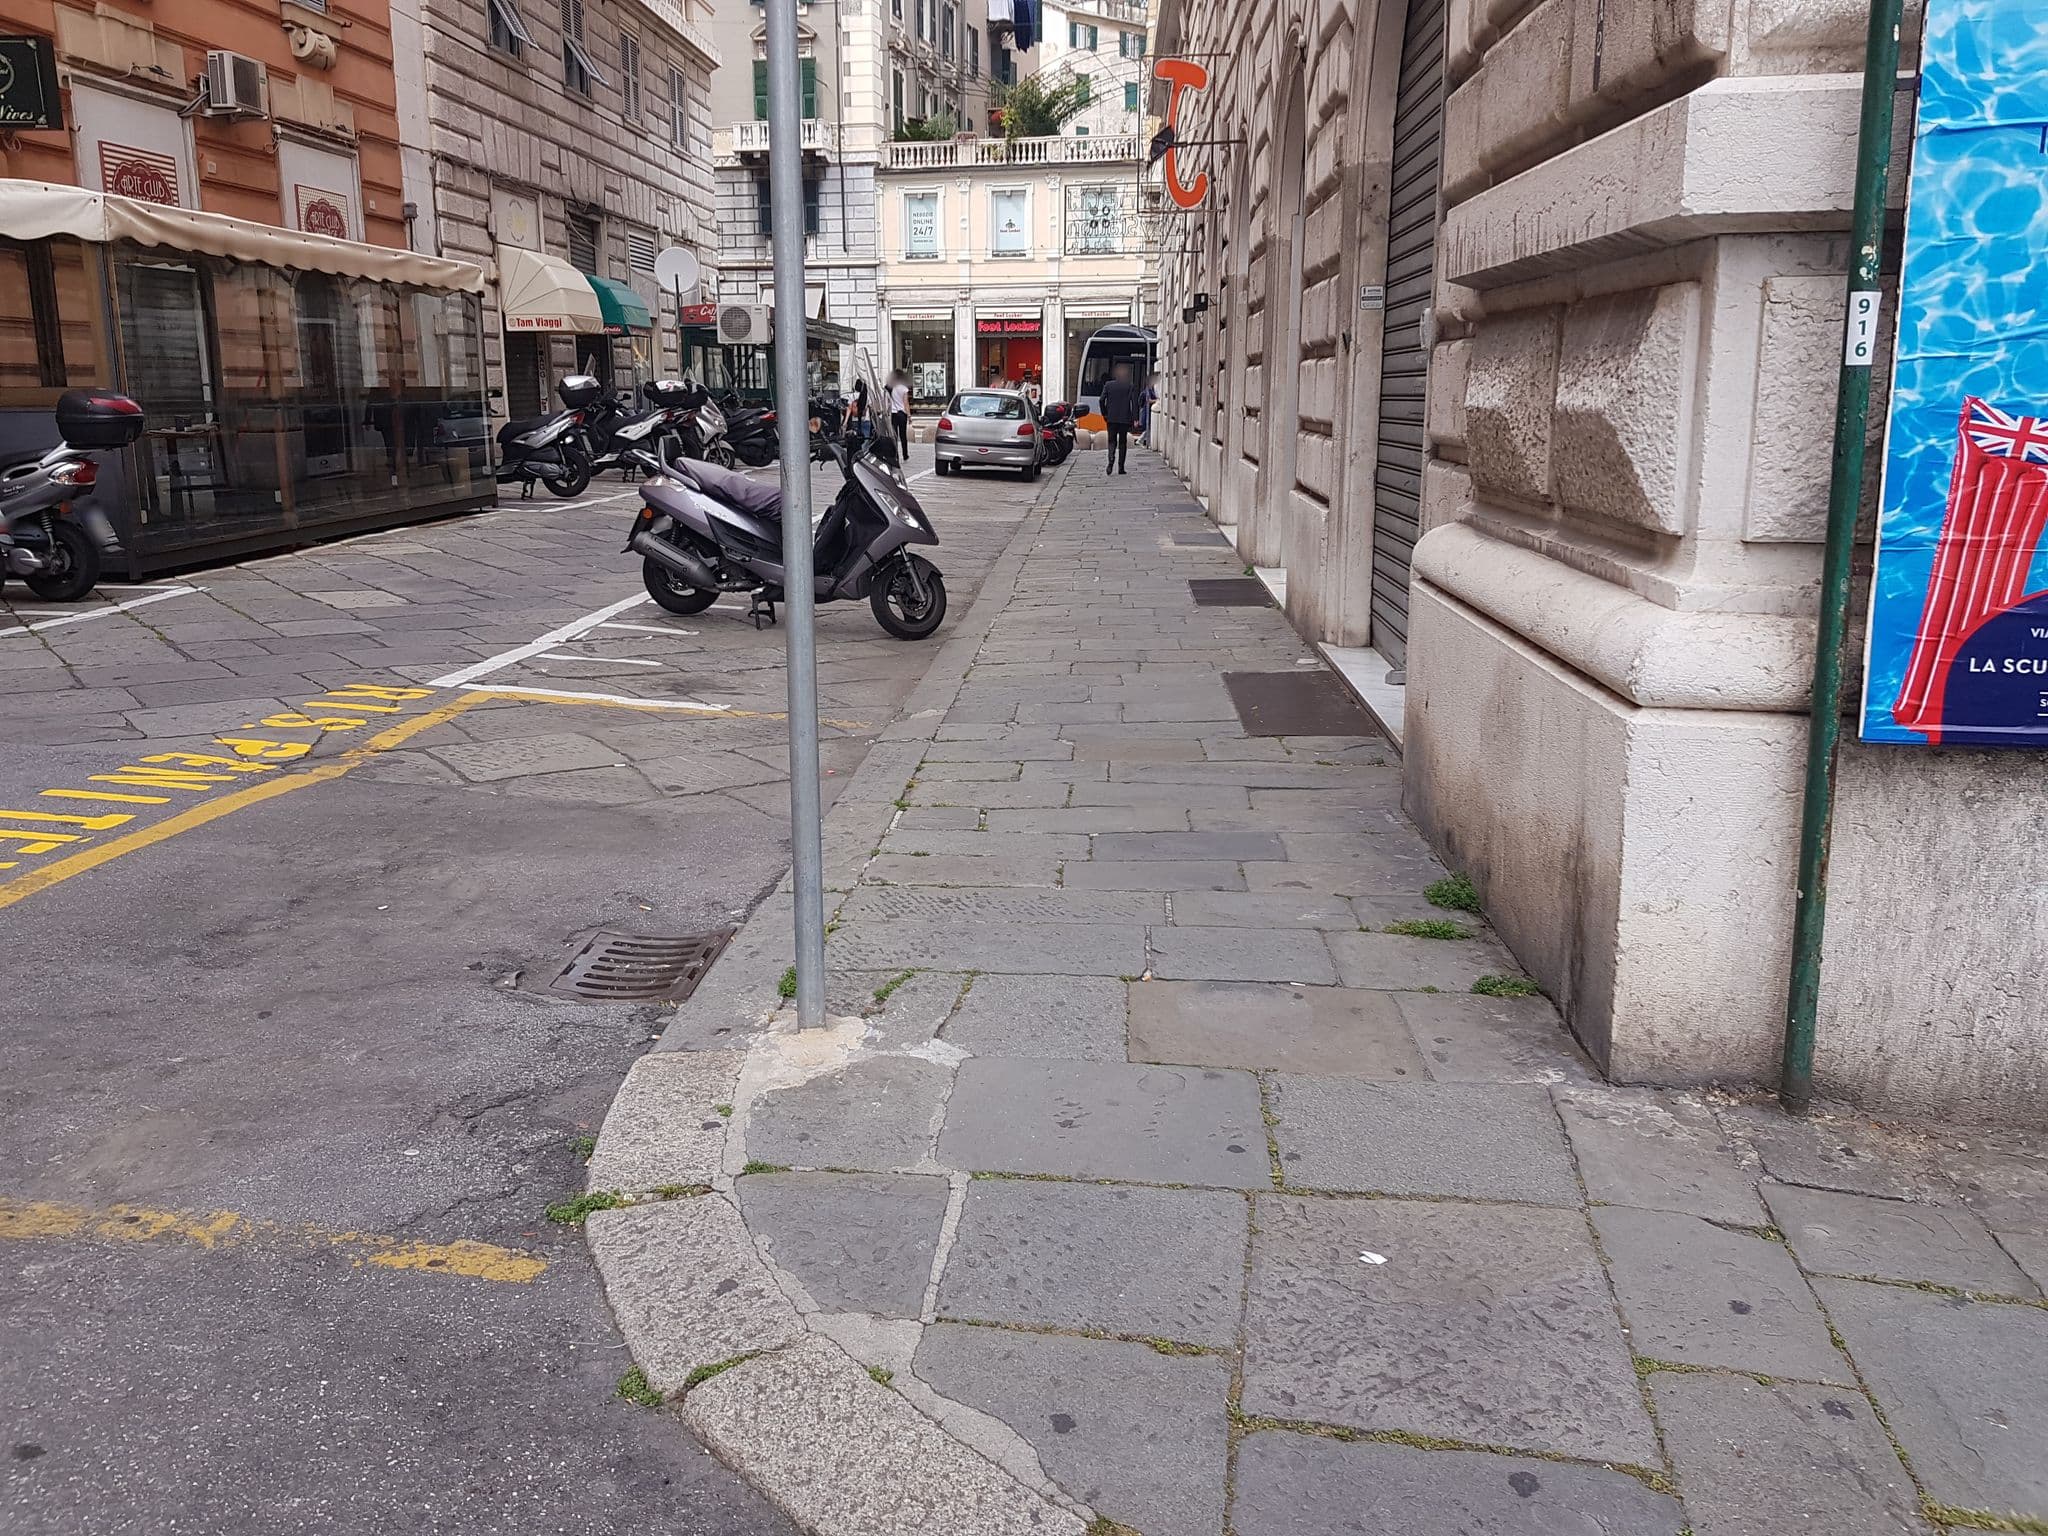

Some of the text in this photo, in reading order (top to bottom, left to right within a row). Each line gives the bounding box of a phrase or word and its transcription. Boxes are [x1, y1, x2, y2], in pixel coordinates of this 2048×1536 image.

[144, 179, 165, 198] CLUB
[913, 226, 934, 236] 24/7
[516, 317, 562, 329] Tam Viaggi
[977, 320, 1040, 332] Foot Locker
[1854, 297, 1871, 357] 916
[2030, 627, 2048, 639] VI
[1969, 657, 2048, 675] LA SCU
